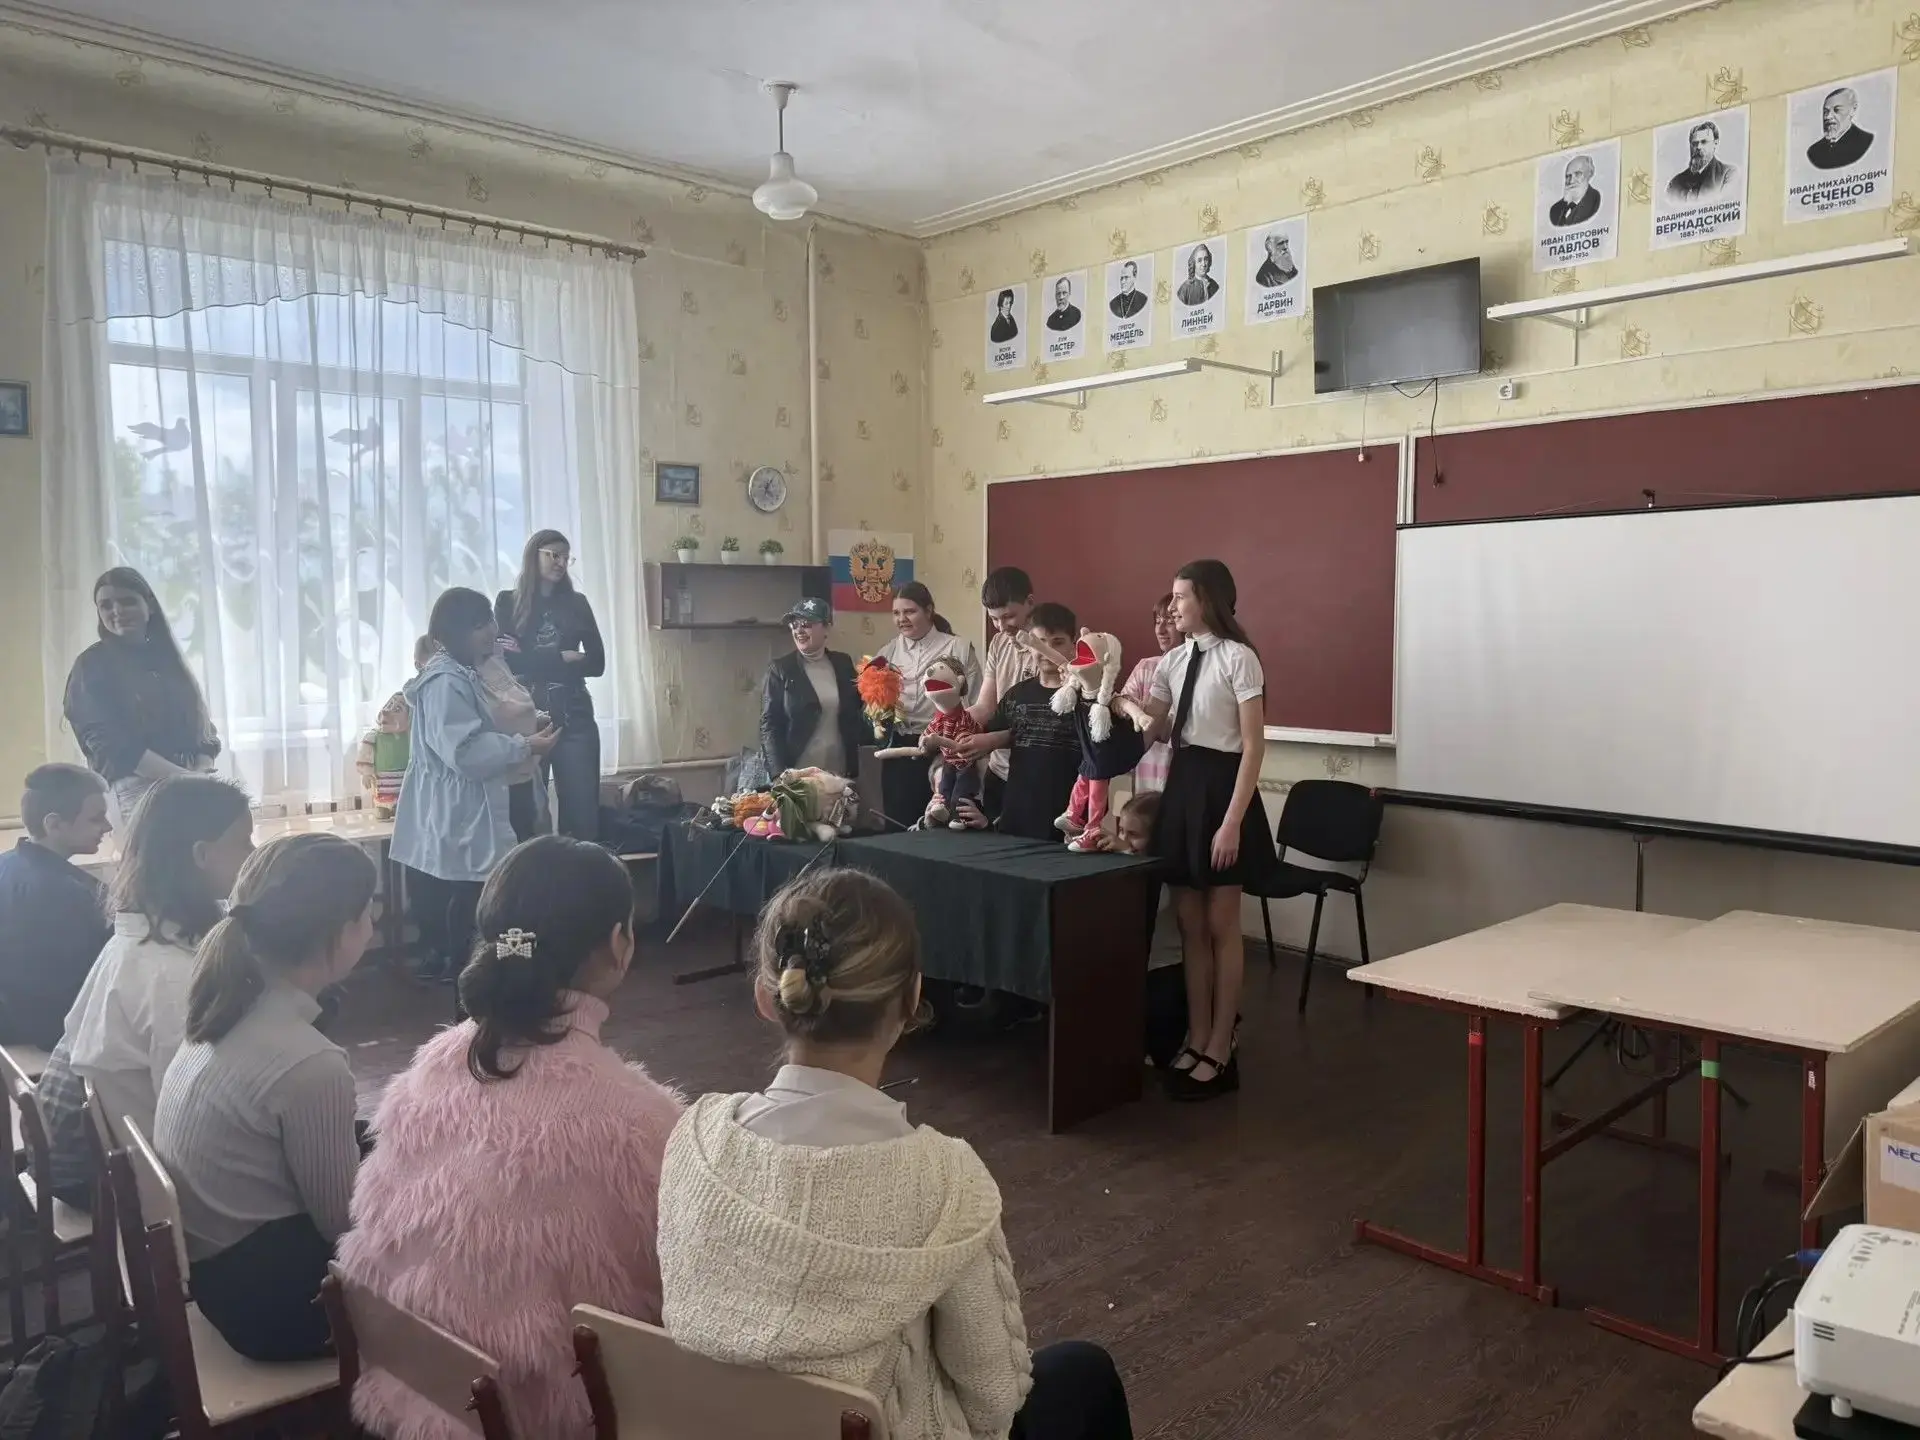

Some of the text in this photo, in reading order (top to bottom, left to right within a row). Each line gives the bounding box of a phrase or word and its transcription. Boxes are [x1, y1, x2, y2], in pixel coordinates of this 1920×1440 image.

[1790, 169, 1888, 195] ИВАН МИХАЙЛОВИЧ
[1801, 182, 1874, 205] СЕЧЕНОВ
[1656, 201, 1741, 223] ВЛАДИМИР ИВАНОВИЧ
[1817, 199, 1856, 211] 1829-1905
[1656, 208, 1741, 235] ВЕРНАДСКИЙ
[1541, 227, 1609, 246] ИВАН ПЕТРОВИЧ
[1549, 238, 1600, 256] ПАВЛОВ
[1257, 297, 1293, 314] ДАРВИН
[1181, 311, 1213, 328] ЛИННЕЙ
[1110, 328, 1144, 341] МЕНДЕЛЬ
[1050, 341, 1075, 353] ПАСТЕР
[995, 351, 1016, 362] КЮВЬЕ
[1888, 1144, 1920, 1162] NEC
